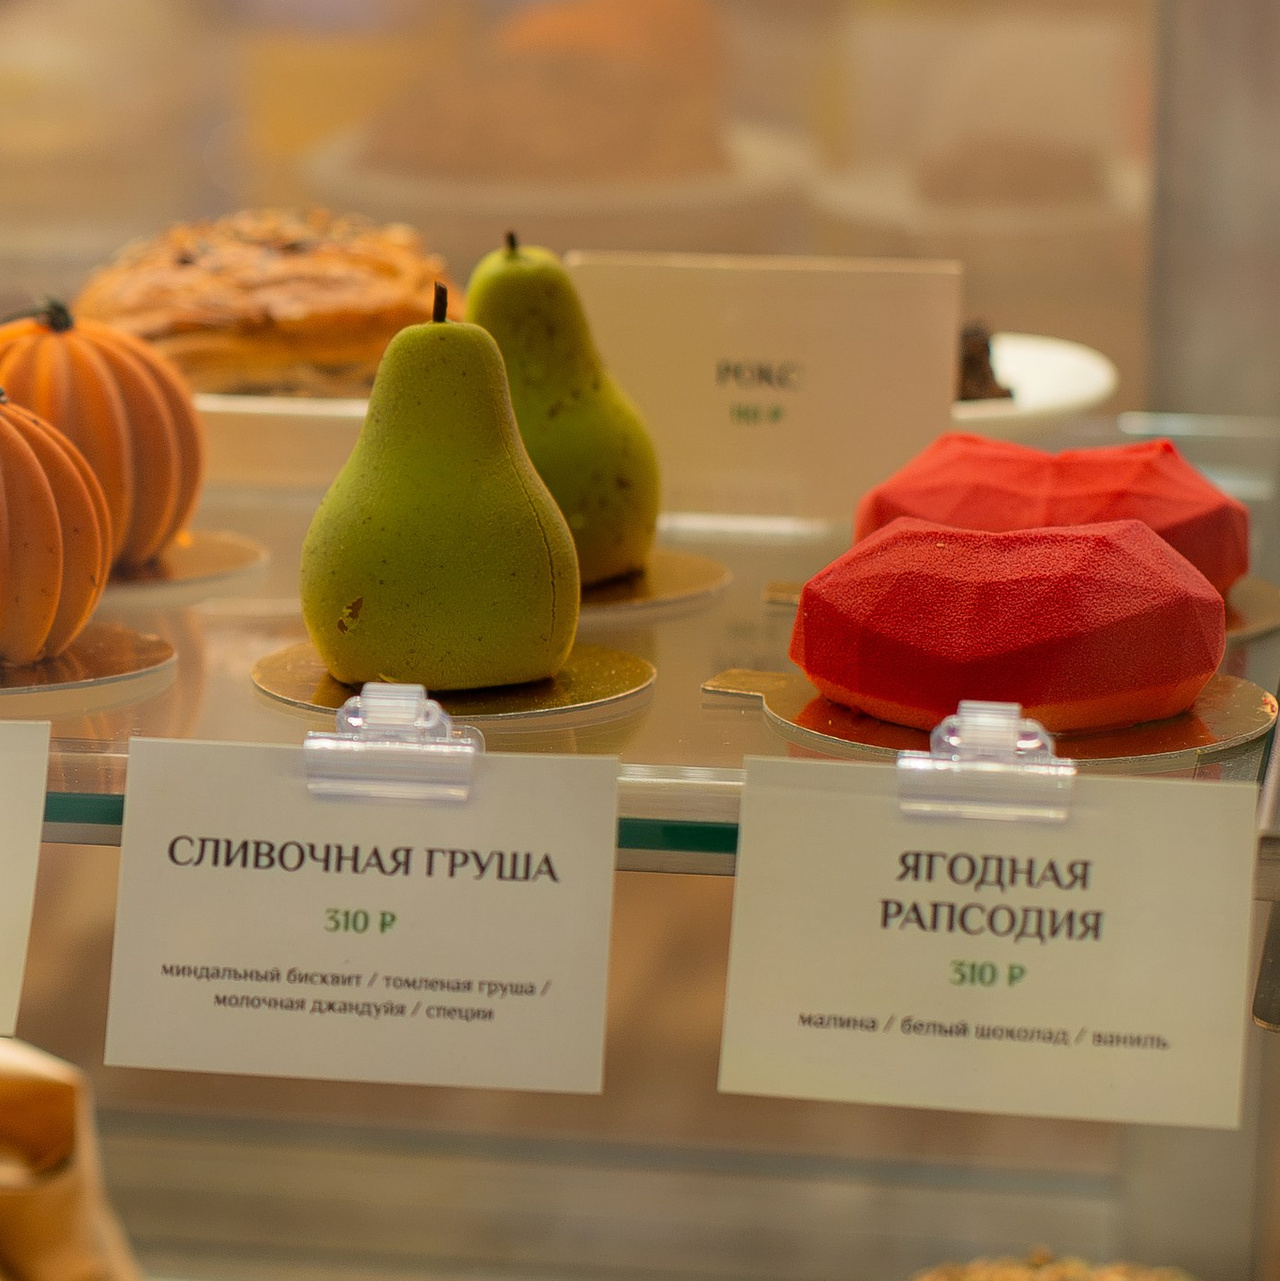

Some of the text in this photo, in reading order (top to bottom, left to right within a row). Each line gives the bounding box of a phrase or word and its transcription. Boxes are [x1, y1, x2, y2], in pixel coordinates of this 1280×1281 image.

[167, 835, 559, 883] СЛИВОЧНАЯ ГРУША
[896, 851, 1092, 892] ЯГОДНАЯ
[325, 908, 369, 934] 310
[880, 898, 1104, 945] РАПСОДИЯ
[161, 961, 281, 983] миндальный
[286, 968, 362, 987] бисквит
[384, 974, 472, 993] томленая
[478, 978, 535, 998] груша
[949, 959, 998, 987] 310
[214, 993, 305, 1011] молочная
[310, 999, 405, 1018] джандуйя
[426, 1004, 494, 1022] специи
[799, 1011, 877, 1033] малина
[901, 1015, 968, 1037] белый
[975, 1023, 1069, 1047] шоколад
[1092, 1030, 1169, 1050] ваниль
